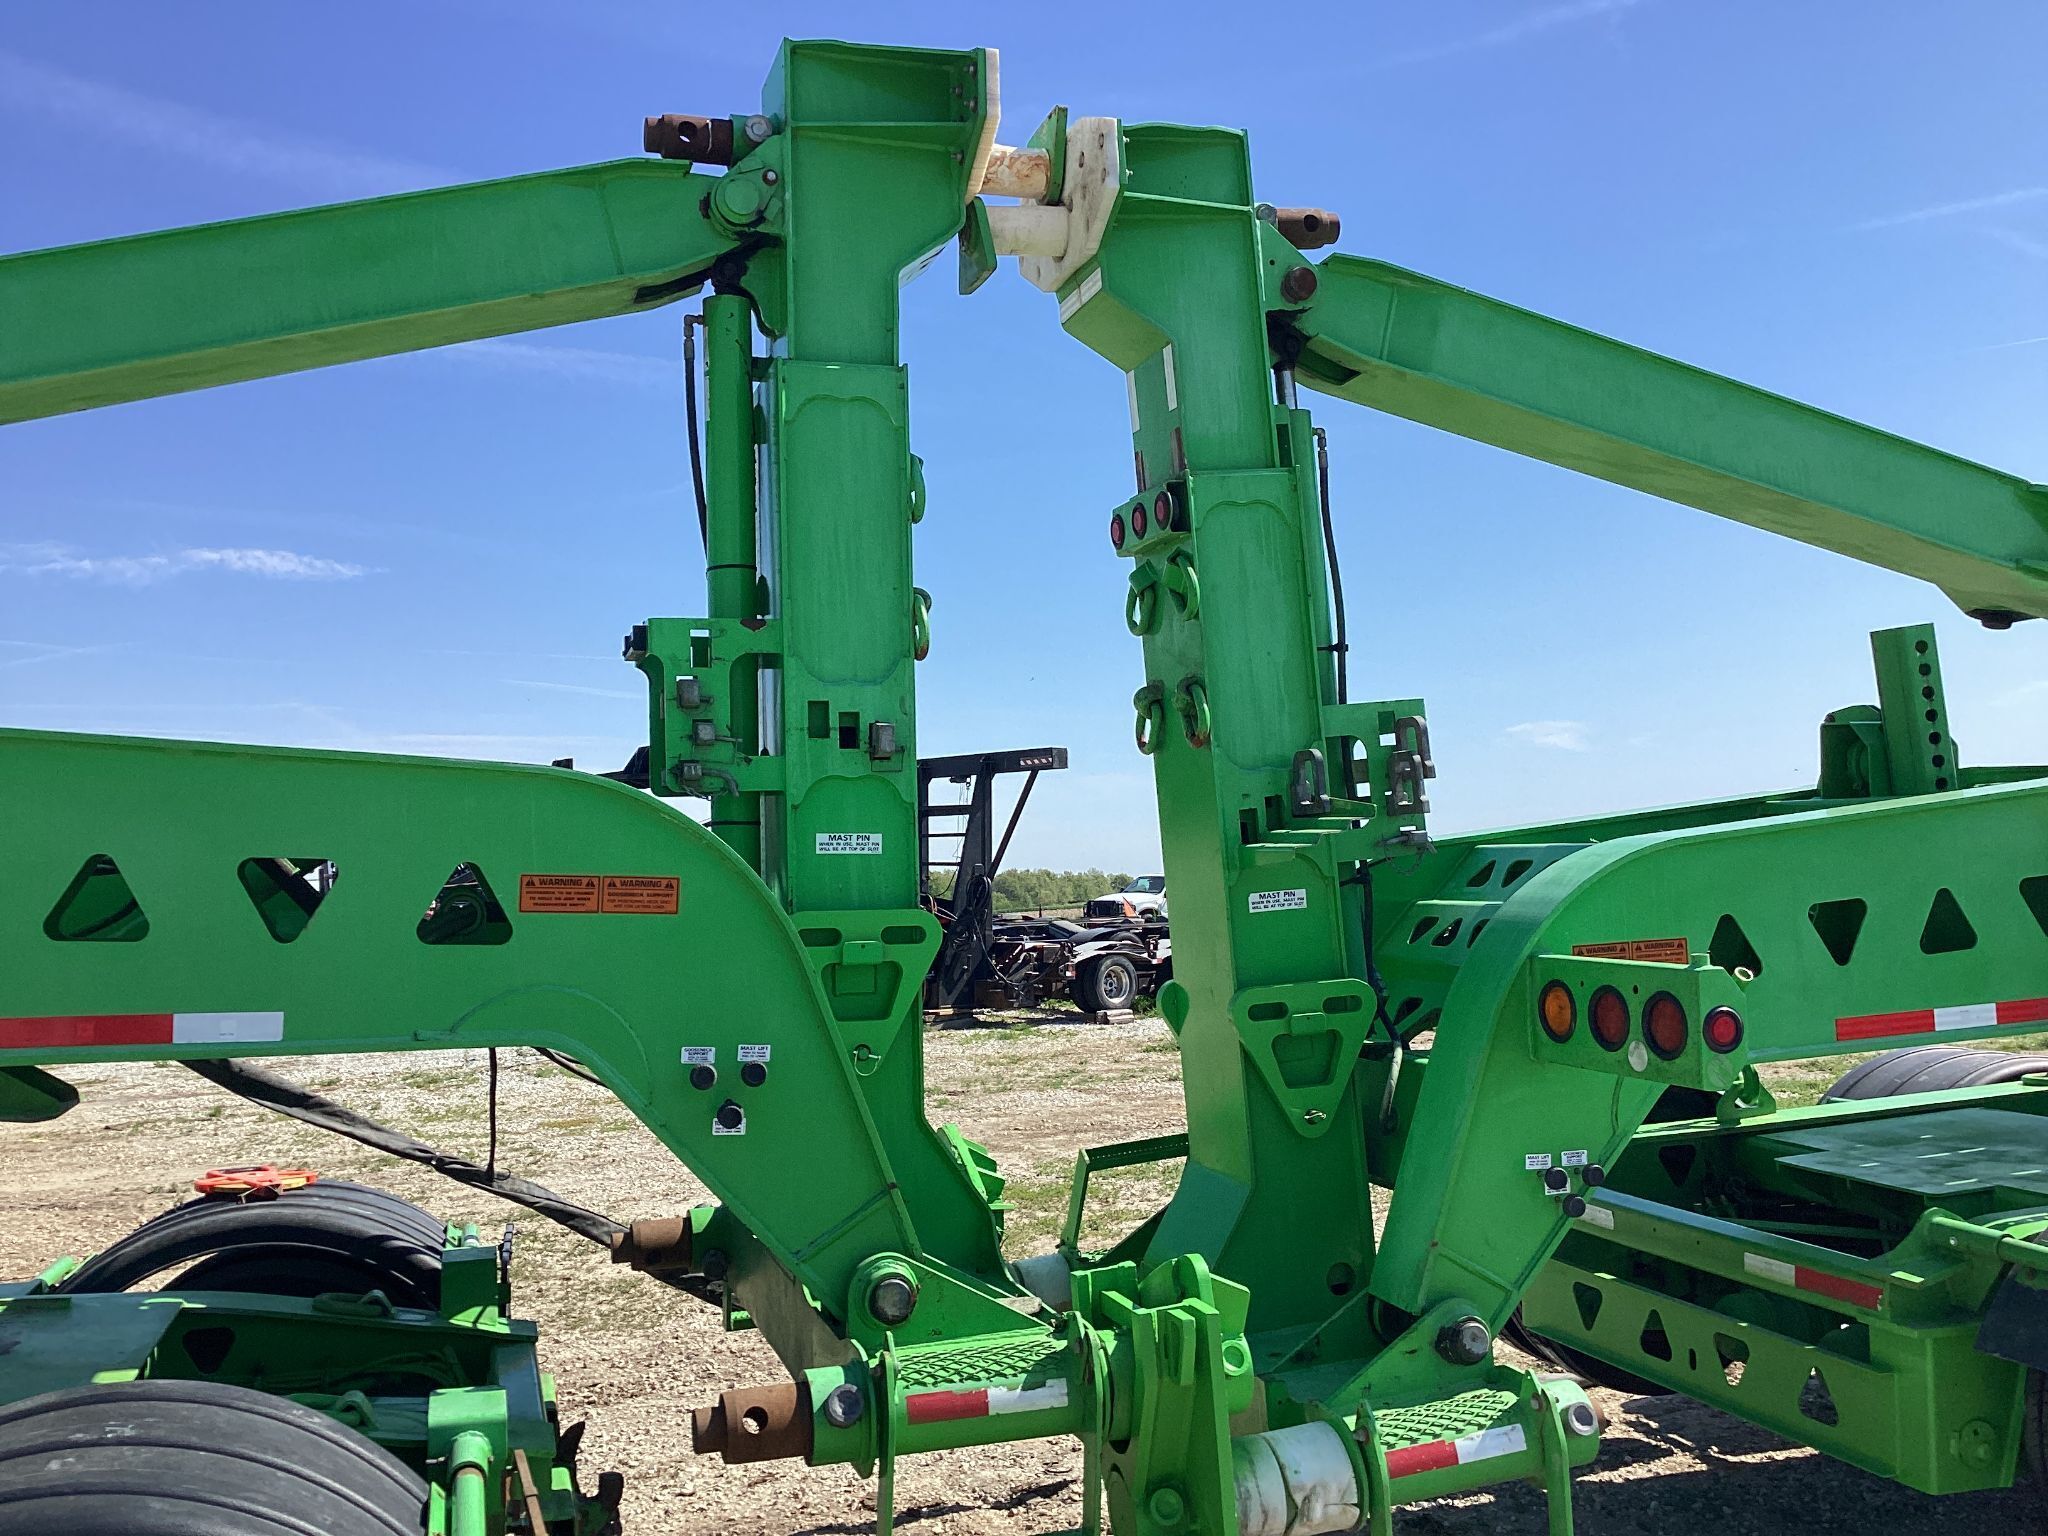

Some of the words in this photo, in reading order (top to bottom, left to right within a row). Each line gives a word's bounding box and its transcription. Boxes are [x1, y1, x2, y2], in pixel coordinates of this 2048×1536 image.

[539, 878, 583, 886] WARNING
[1259, 892, 1280, 900] MAST
[1585, 946, 1617, 954] WARNING
